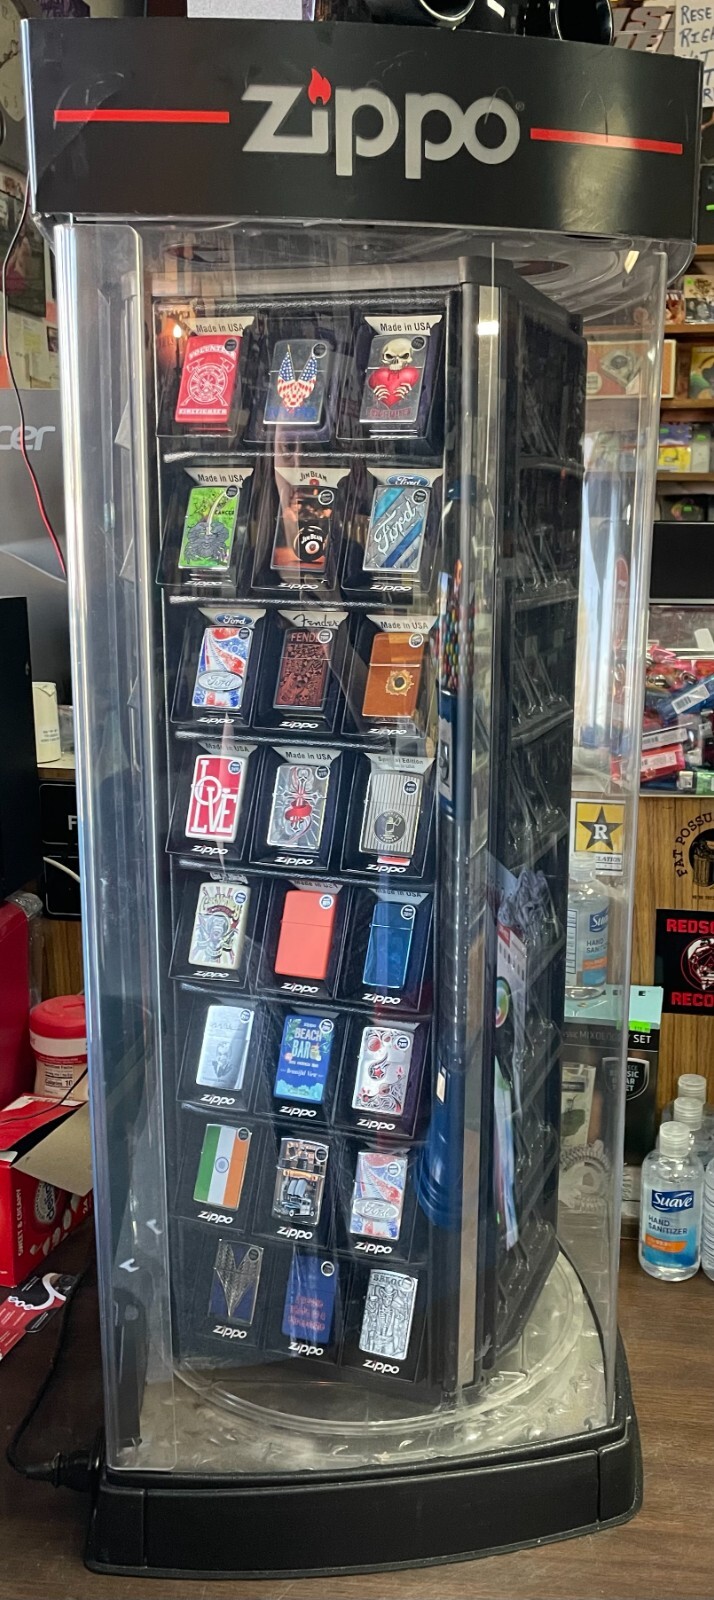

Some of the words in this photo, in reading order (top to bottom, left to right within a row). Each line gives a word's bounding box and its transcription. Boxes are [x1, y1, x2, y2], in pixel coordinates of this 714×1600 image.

[196, 324, 217, 333] Made
[227, 323, 243, 332] USA
[380, 323, 402, 332] Made
[404, 323, 412, 331] in
[414, 322, 431, 331] USA
[197, 474, 218, 483] Made
[219, 474, 227, 482] in
[228, 474, 244, 482] USA
[374, 500, 417, 555] Ford
[222, 615, 247, 625] Ford
[293, 613, 339, 627] Fender
[380, 621, 401, 630] Made
[411, 622, 428, 630] USA
[291, 632, 319, 642] FEND
[285, 751, 305, 760] Made
[307, 752, 315, 760] in
[316, 753, 332, 761] USA
[402, 757, 424, 765] Edition
[593, 823, 609, 840] R
[672, 849, 688, 878] FAT
[294, 1027, 322, 1042] BEACH
[633, 1034, 652, 1044] SET
[291, 1039, 311, 1059] BAR
[653, 1191, 693, 1208] Suave
[648, 1214, 670, 1227] HAND
[648, 1222, 688, 1235] SANITIZER
